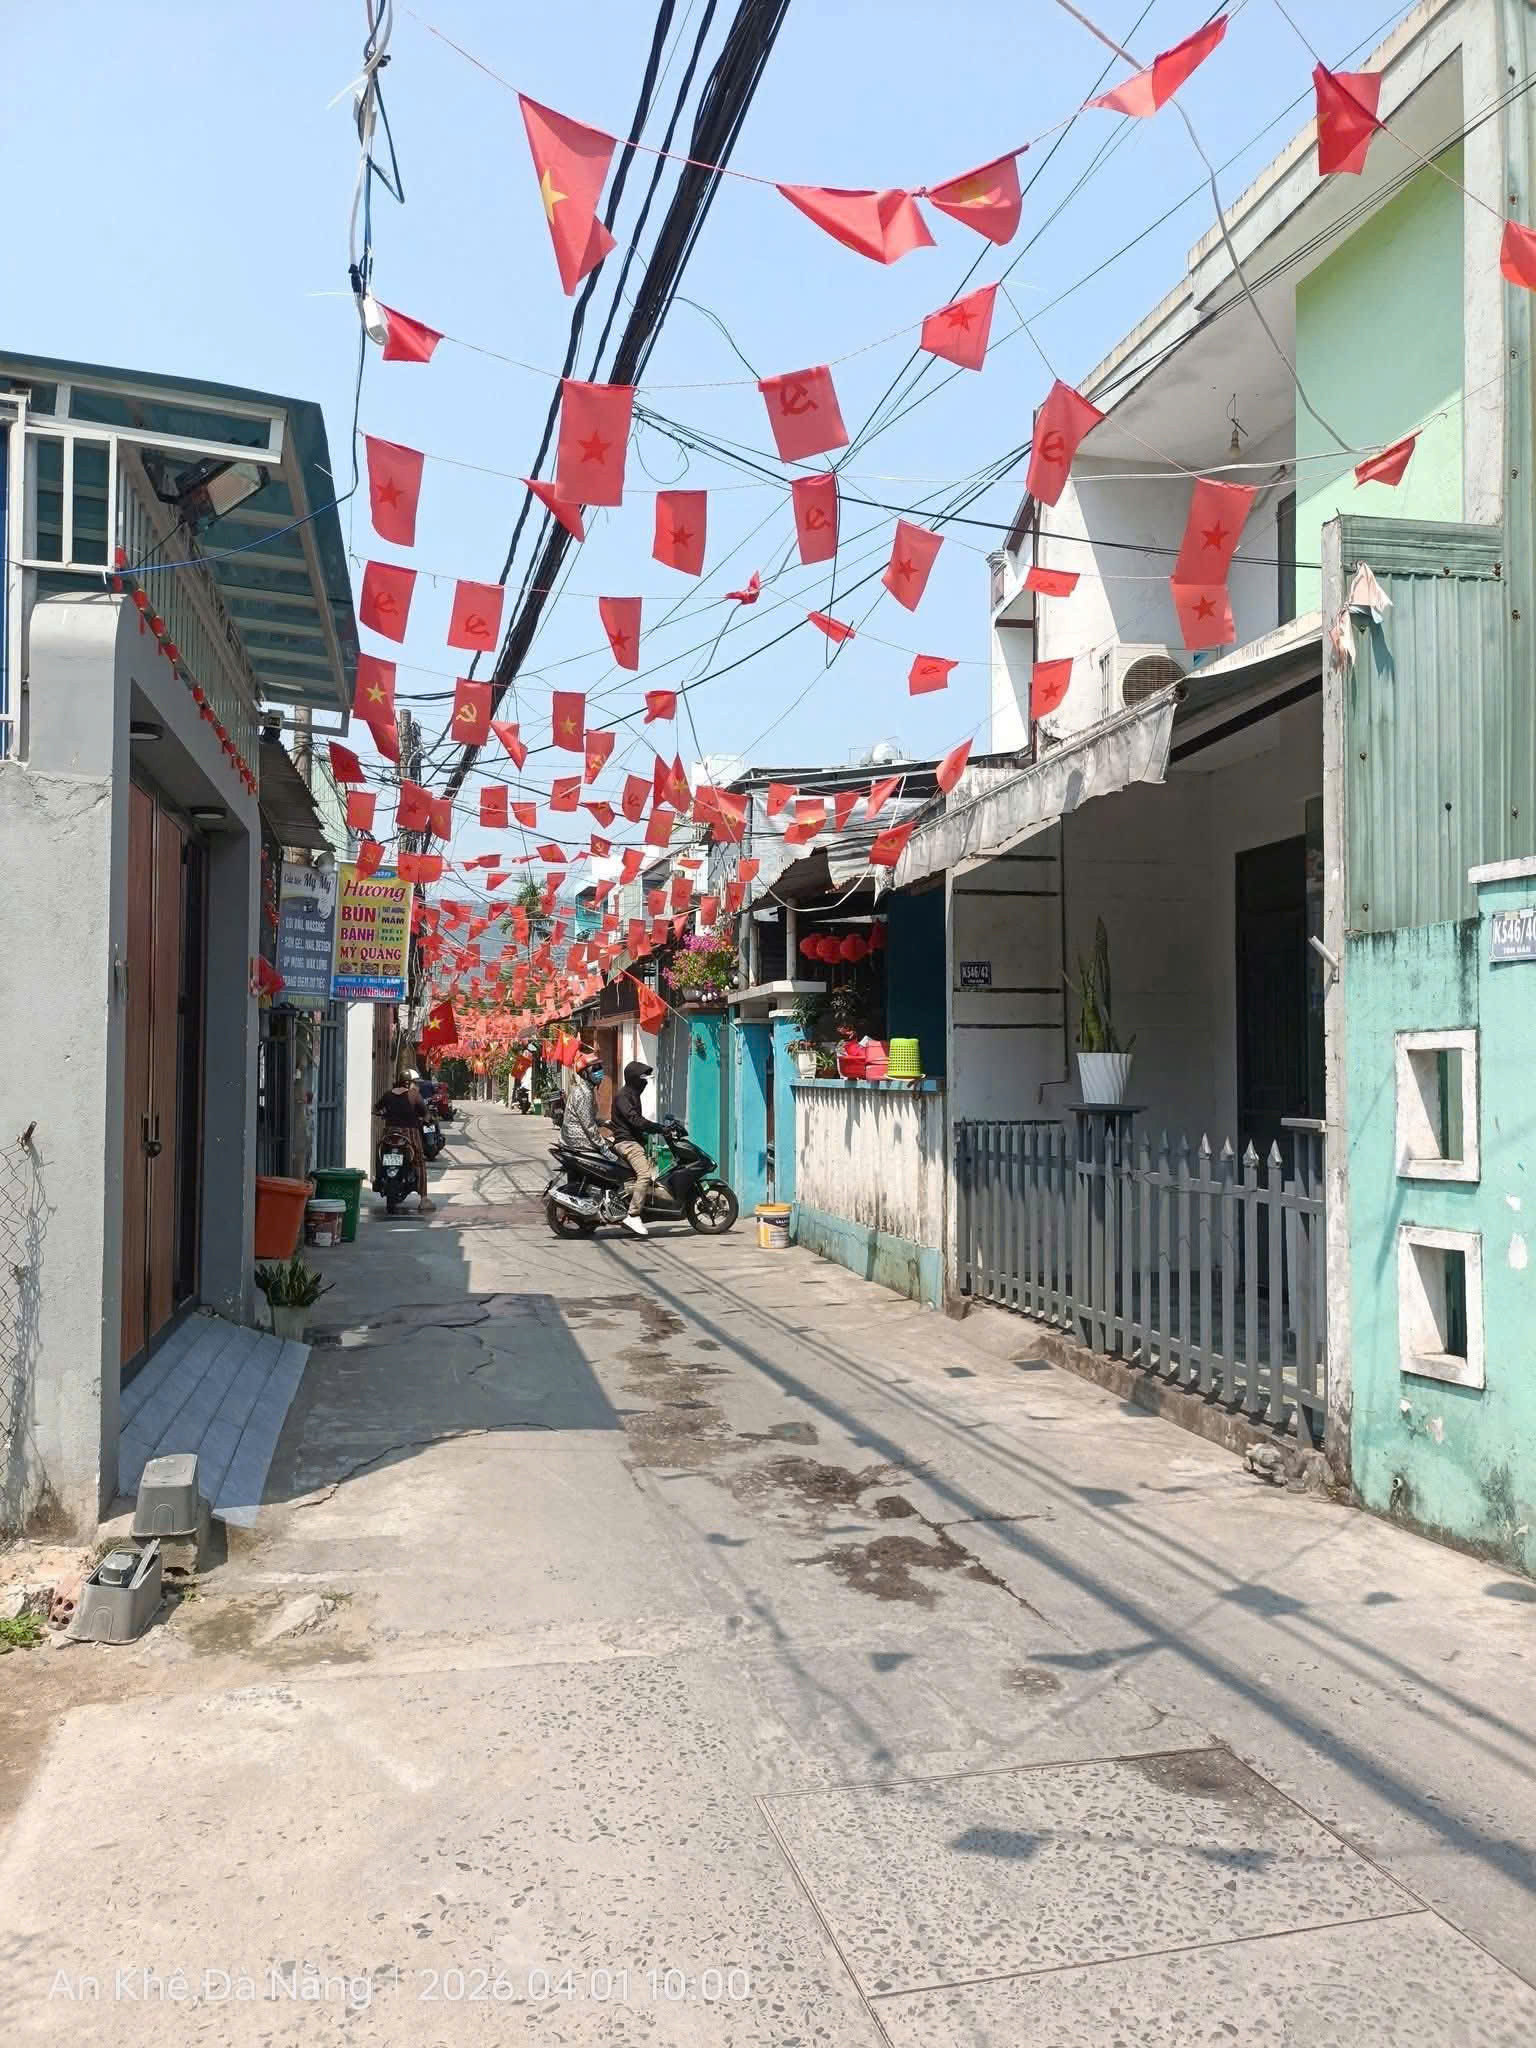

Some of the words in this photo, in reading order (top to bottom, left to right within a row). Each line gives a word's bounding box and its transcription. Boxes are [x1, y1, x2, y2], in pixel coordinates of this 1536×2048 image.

[344, 880, 406, 902] Hương
[342, 904, 377, 922] BÚN
[340, 925, 375, 941] BÁNH
[360, 944, 401, 961] QUẢNG
